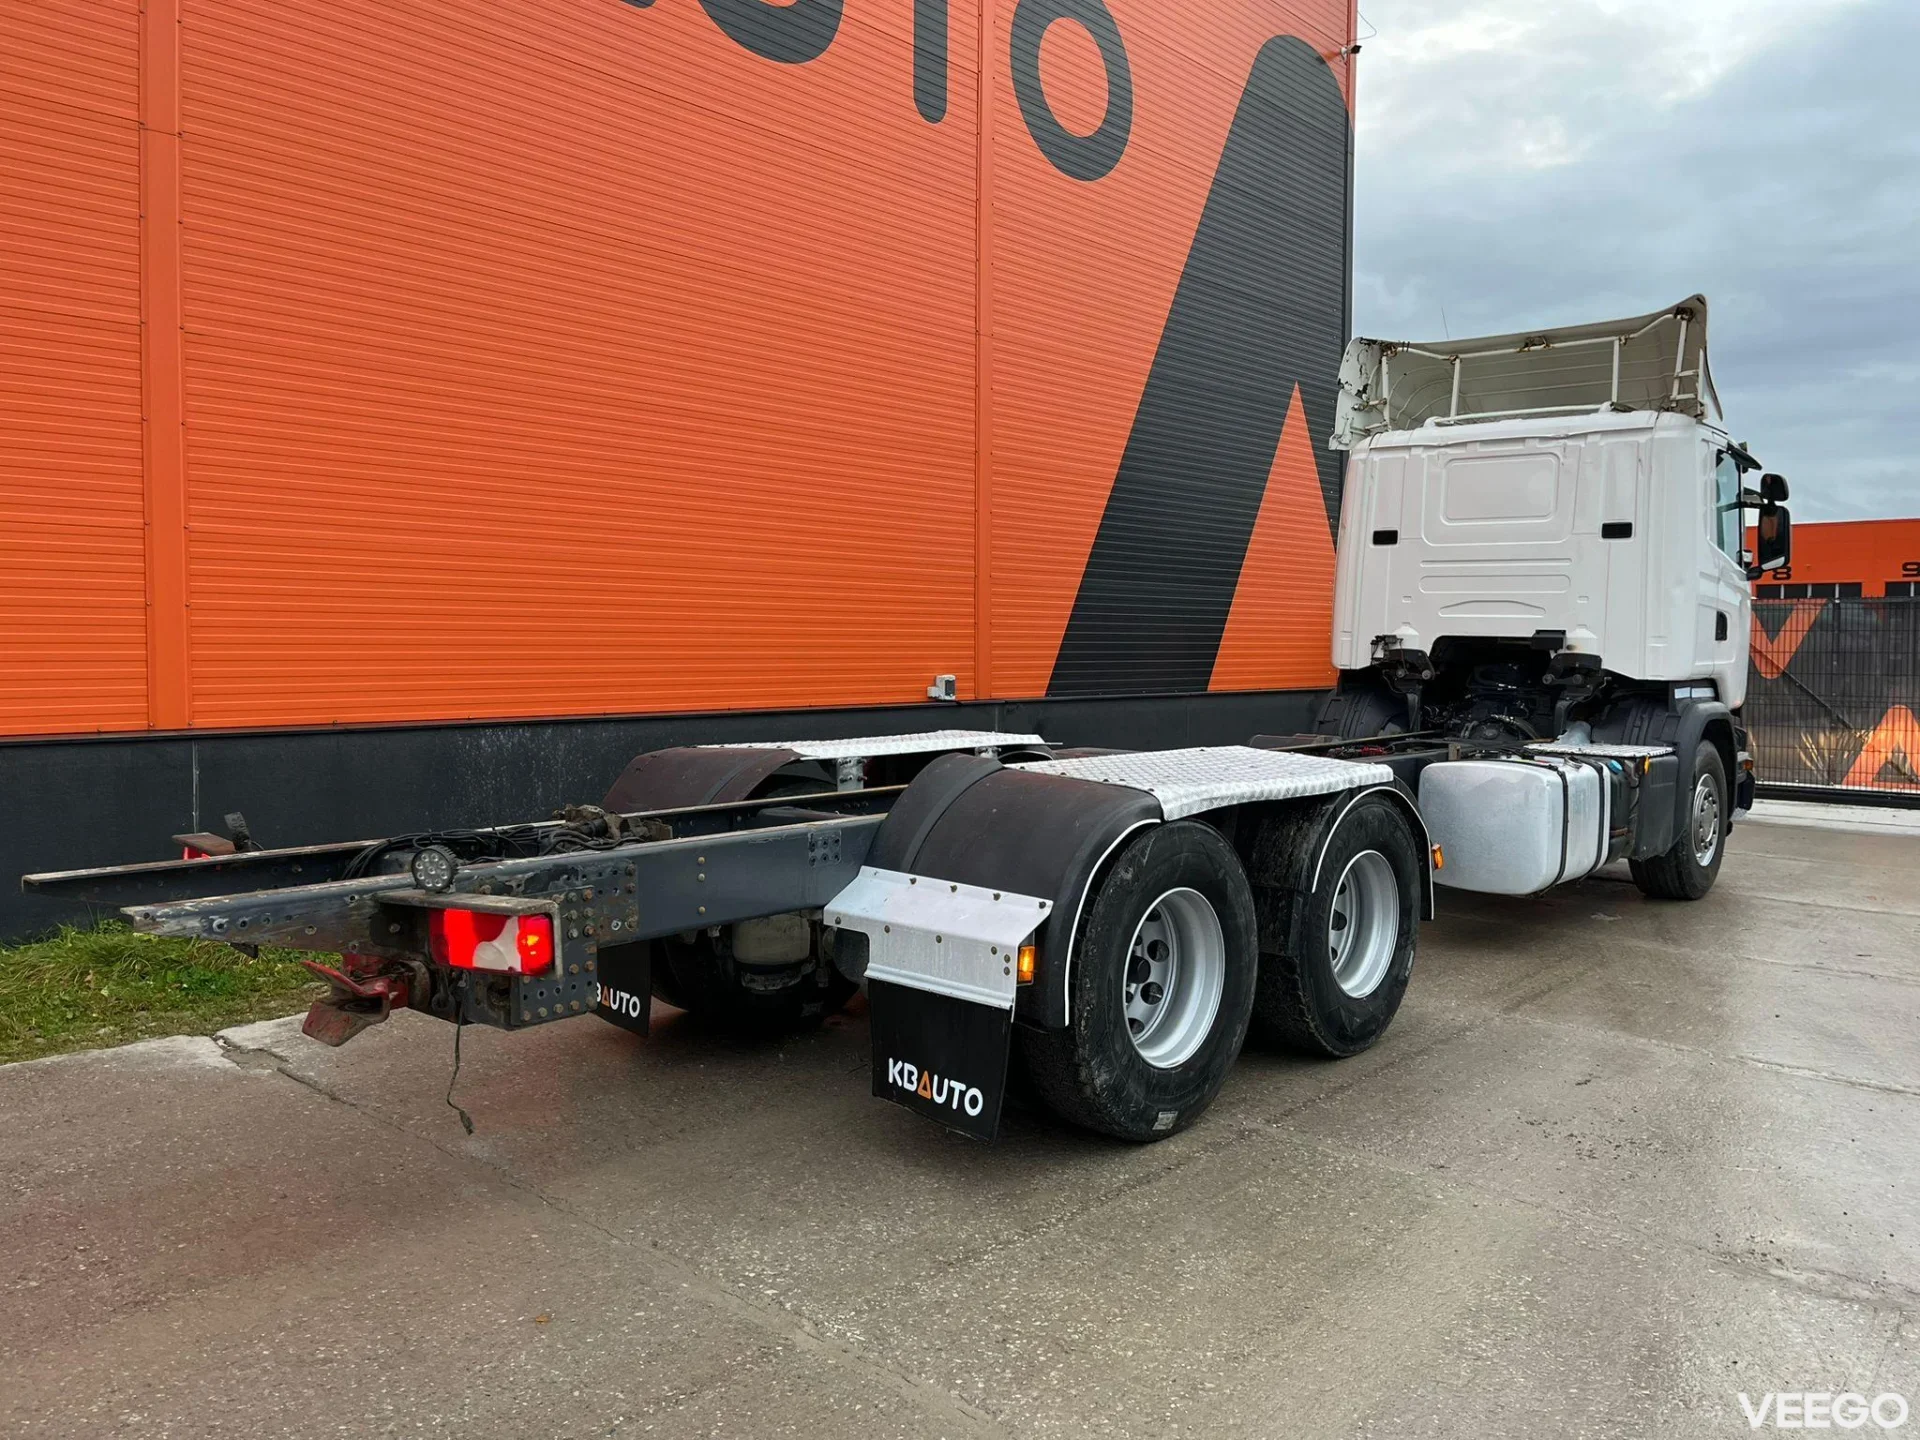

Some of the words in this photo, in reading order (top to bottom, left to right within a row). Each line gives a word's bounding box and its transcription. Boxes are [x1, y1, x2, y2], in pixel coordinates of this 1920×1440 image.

[1772, 565, 1792, 580] 8
[597, 982, 640, 1018] BAUTO
[888, 1057, 984, 1117] KBAUTO
